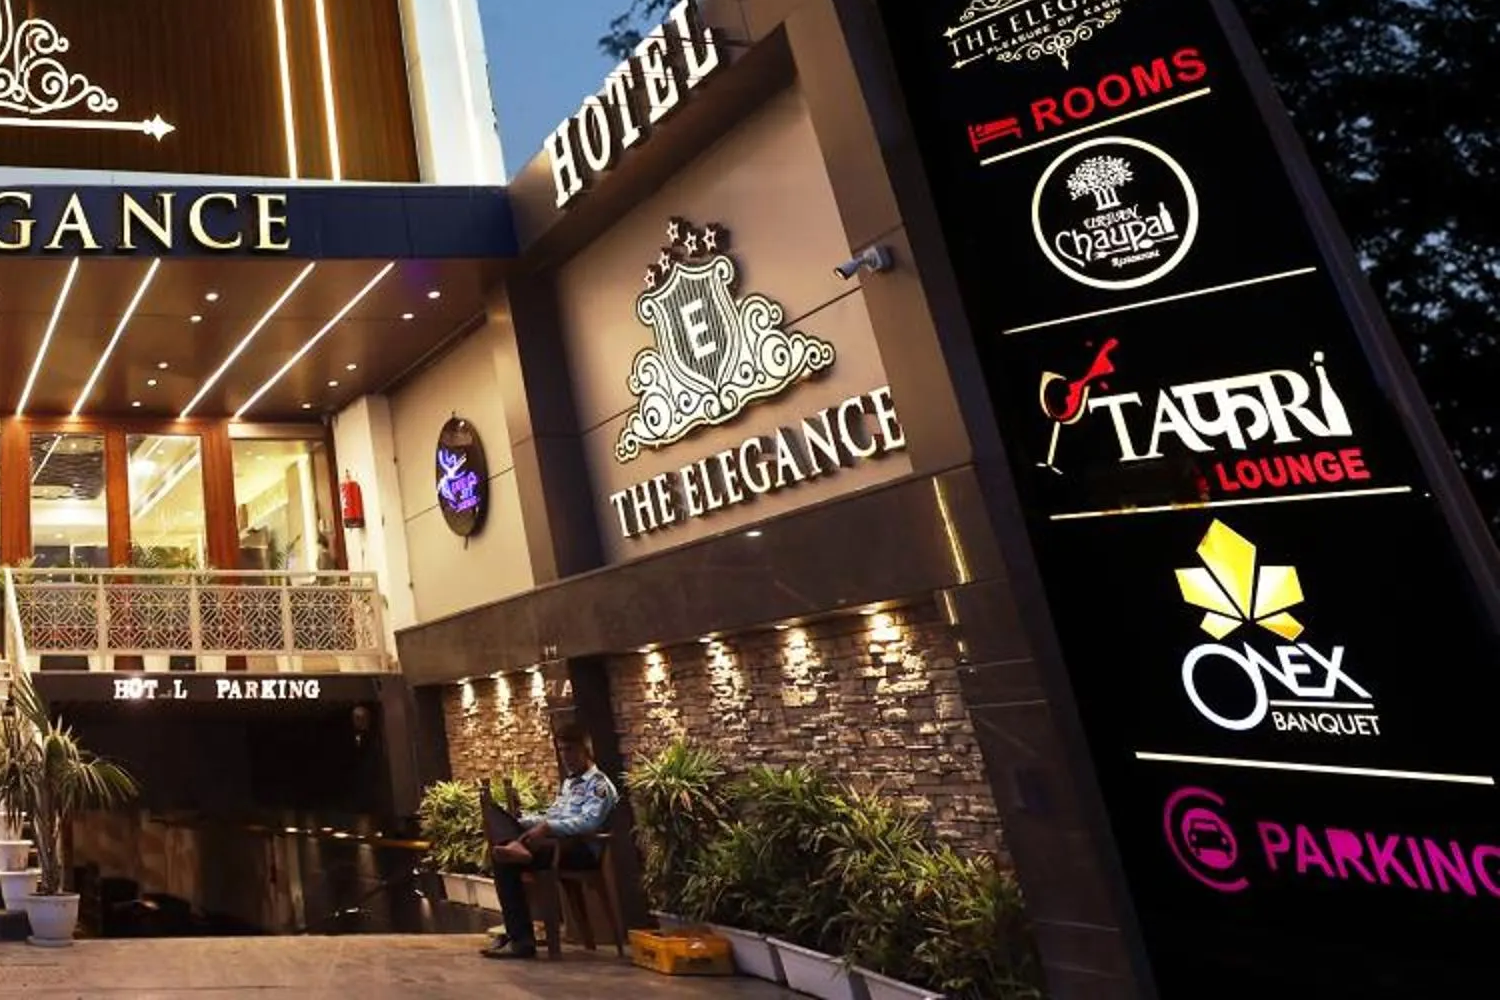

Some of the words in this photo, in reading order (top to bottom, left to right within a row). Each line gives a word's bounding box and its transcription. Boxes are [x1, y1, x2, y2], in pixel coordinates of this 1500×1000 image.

[947, 22, 1002, 57] THE
[986, 24, 1051, 55] PLEASURE
[1029, 47, 1208, 132] ROOMS
[680, 299, 717, 362] E
[610, 470, 676, 539] THE
[680, 385, 907, 519] ELEGANCE
[1215, 447, 1371, 492] LOUNGE
[113, 677, 188, 700] HOTL
[215, 679, 321, 700] PARKING
[1182, 642, 1373, 730] ONEX
[1271, 710, 1381, 736] BANQUET
[1256, 820, 1500, 897] PARKING
